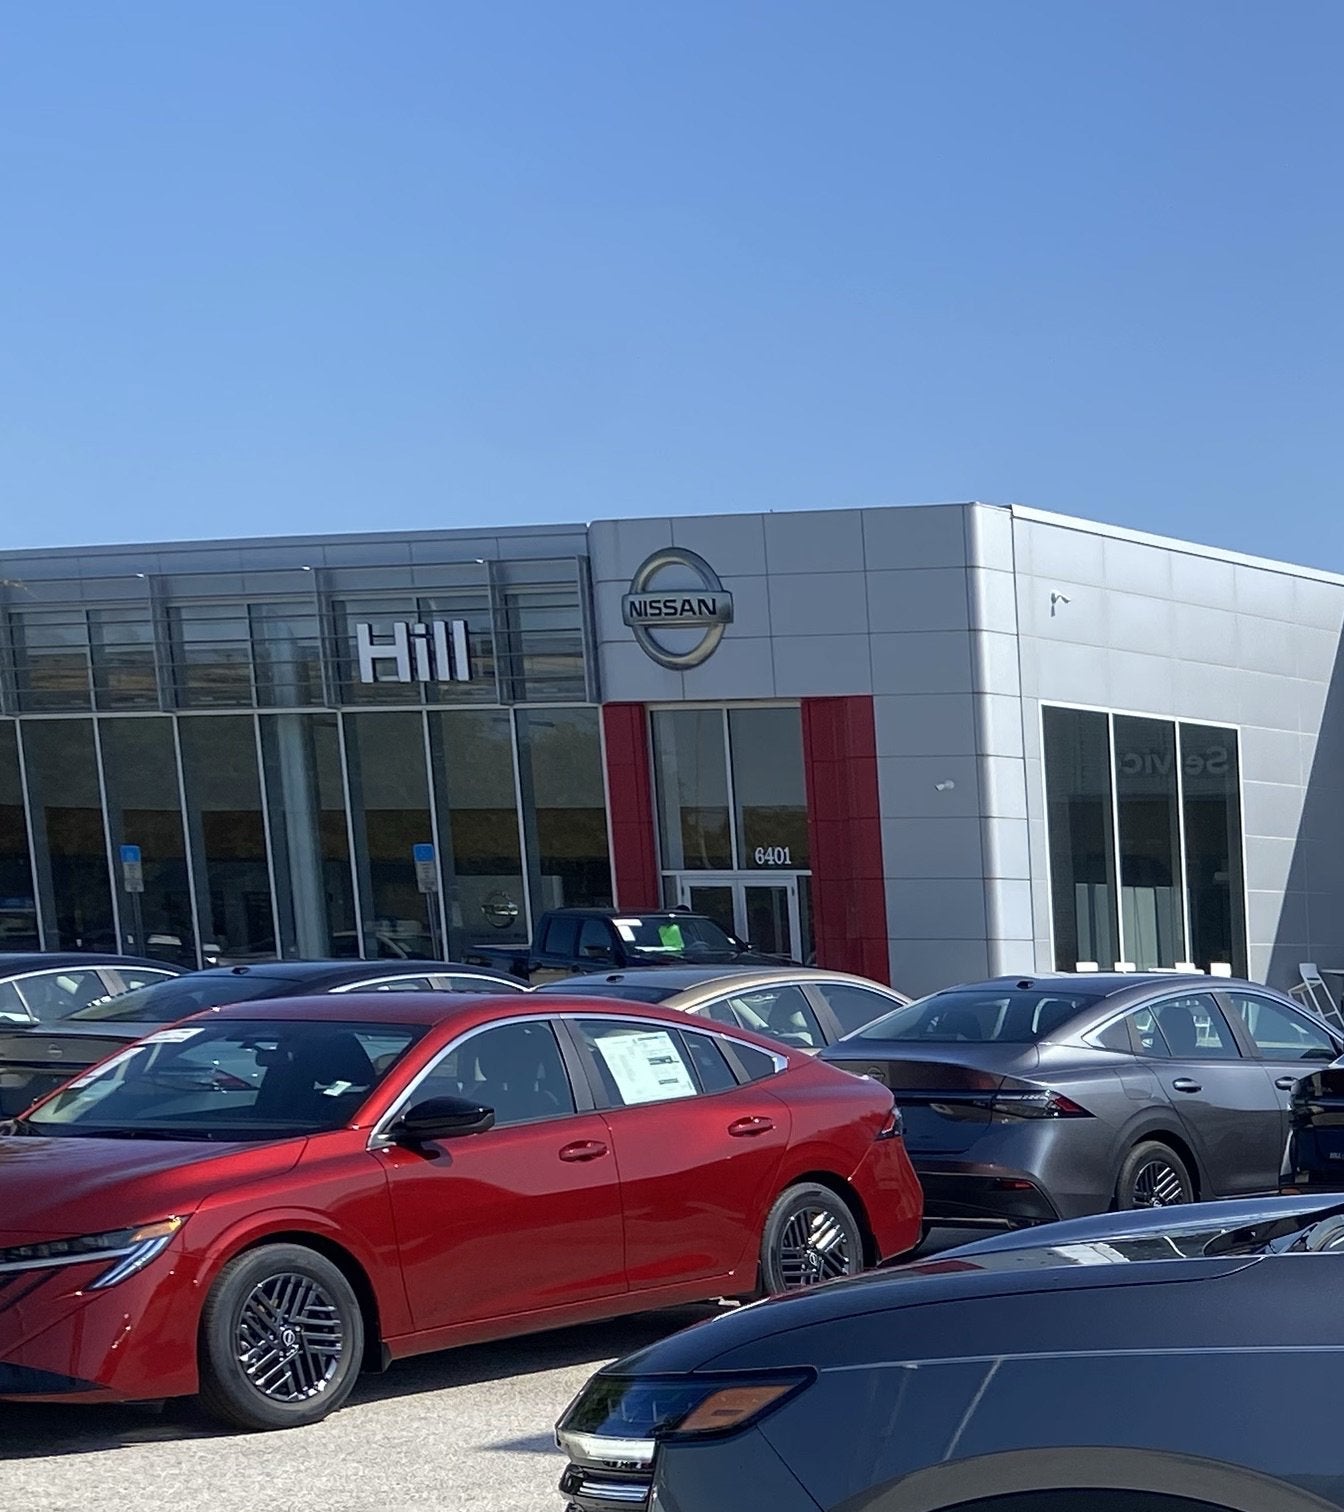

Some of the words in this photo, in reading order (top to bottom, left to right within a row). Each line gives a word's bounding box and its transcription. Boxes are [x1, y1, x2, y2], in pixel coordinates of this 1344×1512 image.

[629, 598, 717, 618] NISSAN
[356, 620, 471, 683] Hill
[755, 846, 792, 865] 6401
